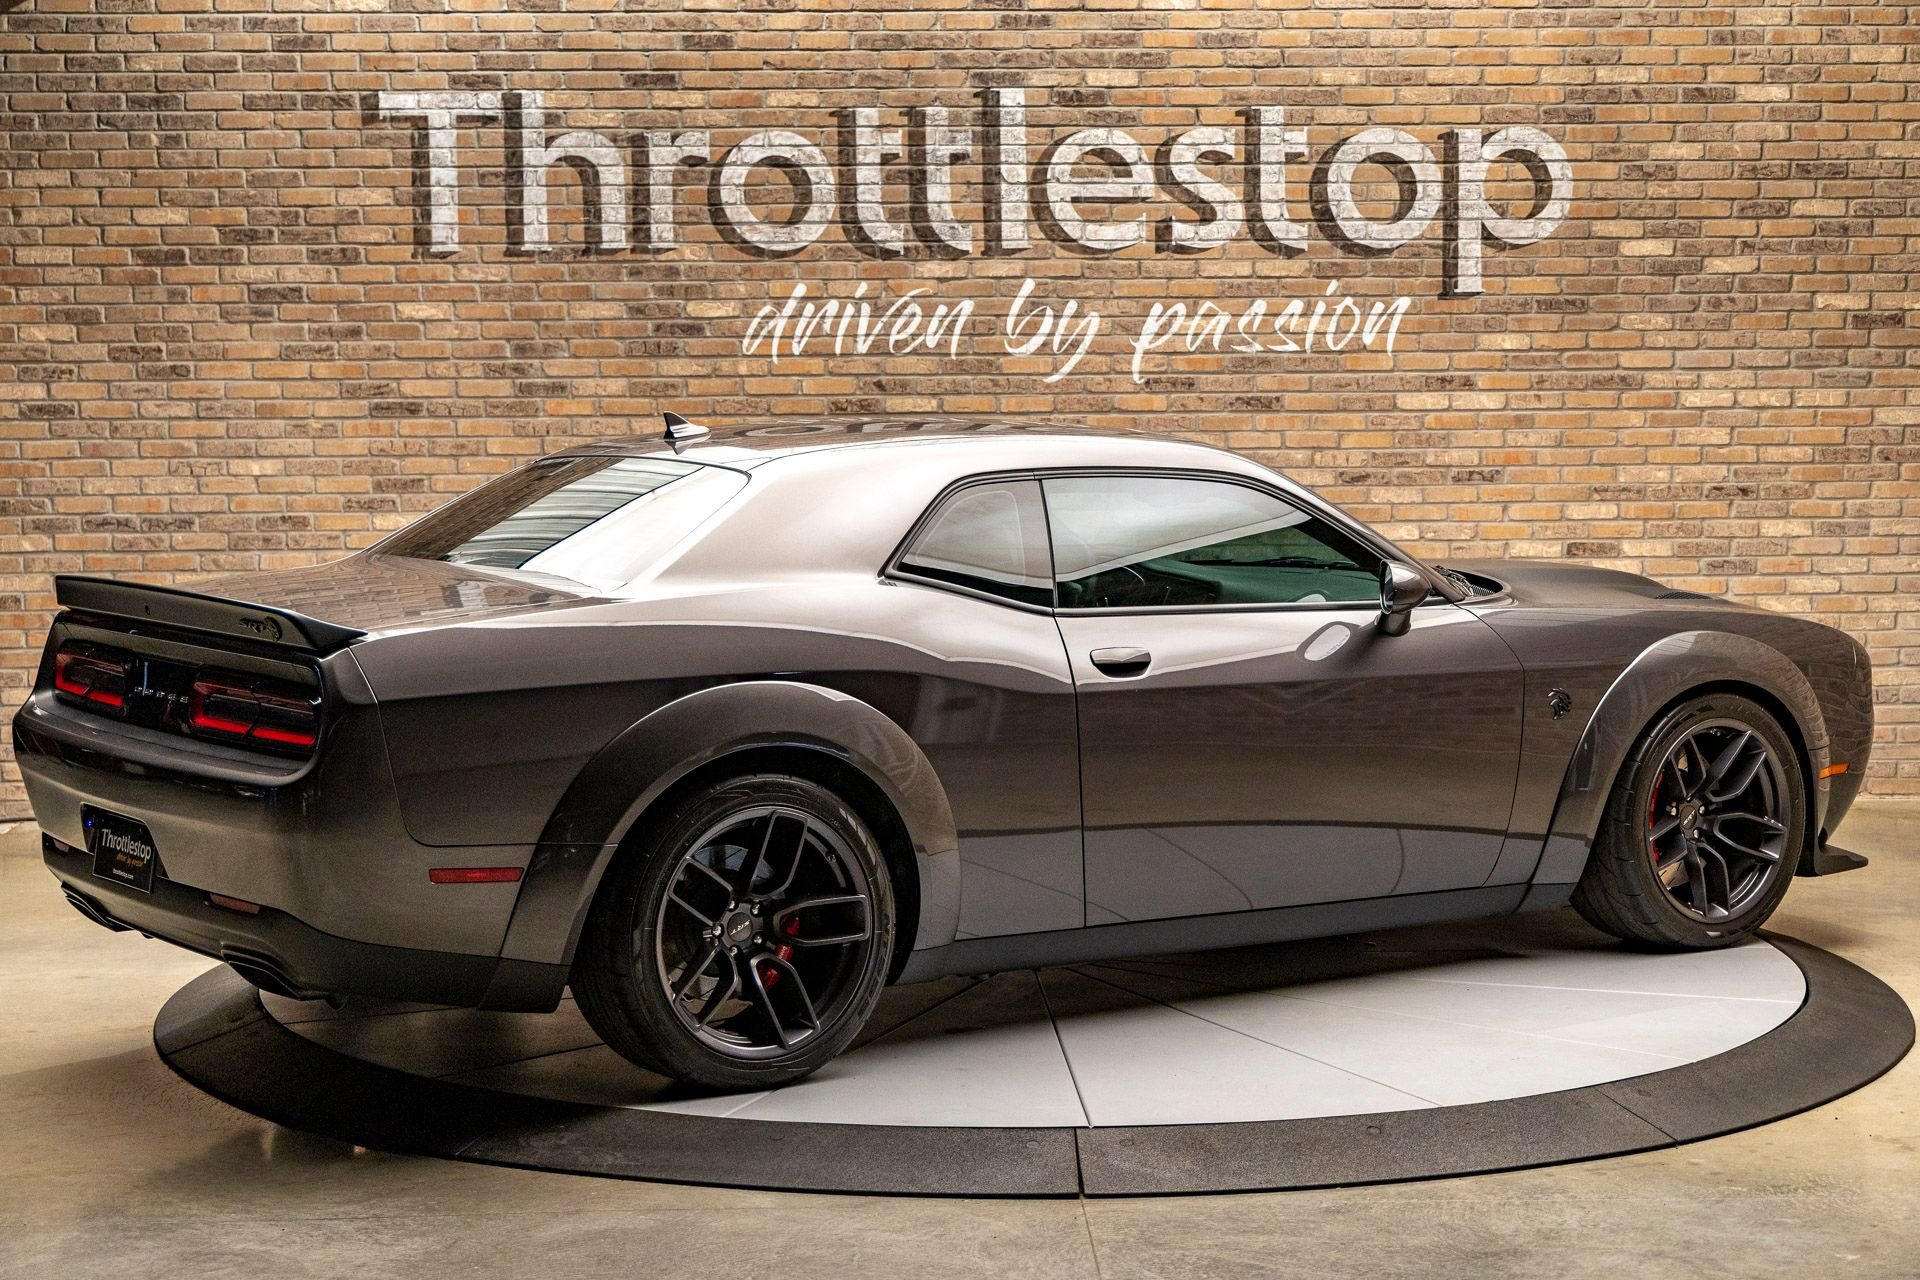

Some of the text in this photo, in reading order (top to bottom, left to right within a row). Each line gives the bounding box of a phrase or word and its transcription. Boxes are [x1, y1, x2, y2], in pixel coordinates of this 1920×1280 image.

[372, 87, 1574, 296] Throttlestop
[742, 277, 1412, 384] driven by passion
[101, 828, 152, 864] Throttlestop
